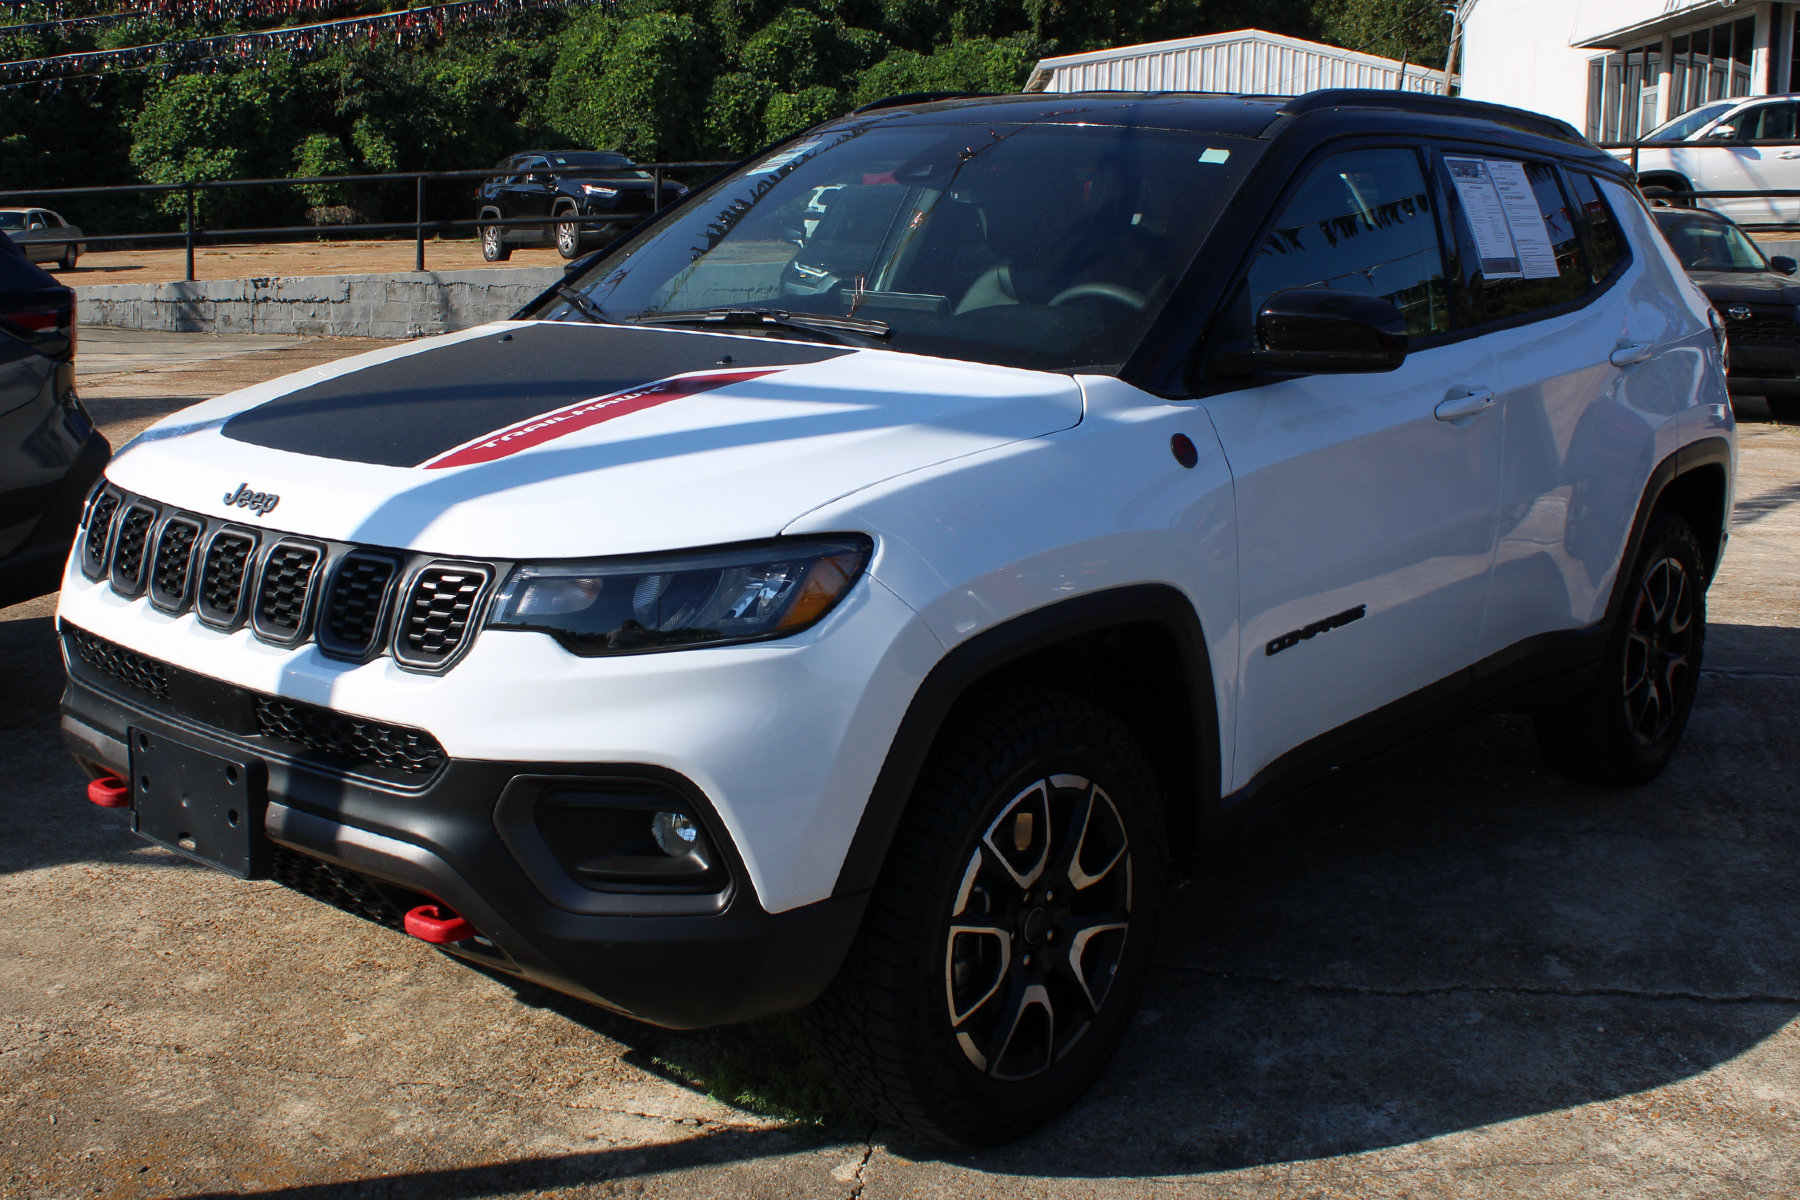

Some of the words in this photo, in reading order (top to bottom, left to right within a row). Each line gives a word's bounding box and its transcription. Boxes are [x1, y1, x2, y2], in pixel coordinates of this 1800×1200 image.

[473, 386, 666, 451] TRAILHAWK
[223, 482, 280, 517] Jeep
[1265, 603, 1366, 657] COMPASS
